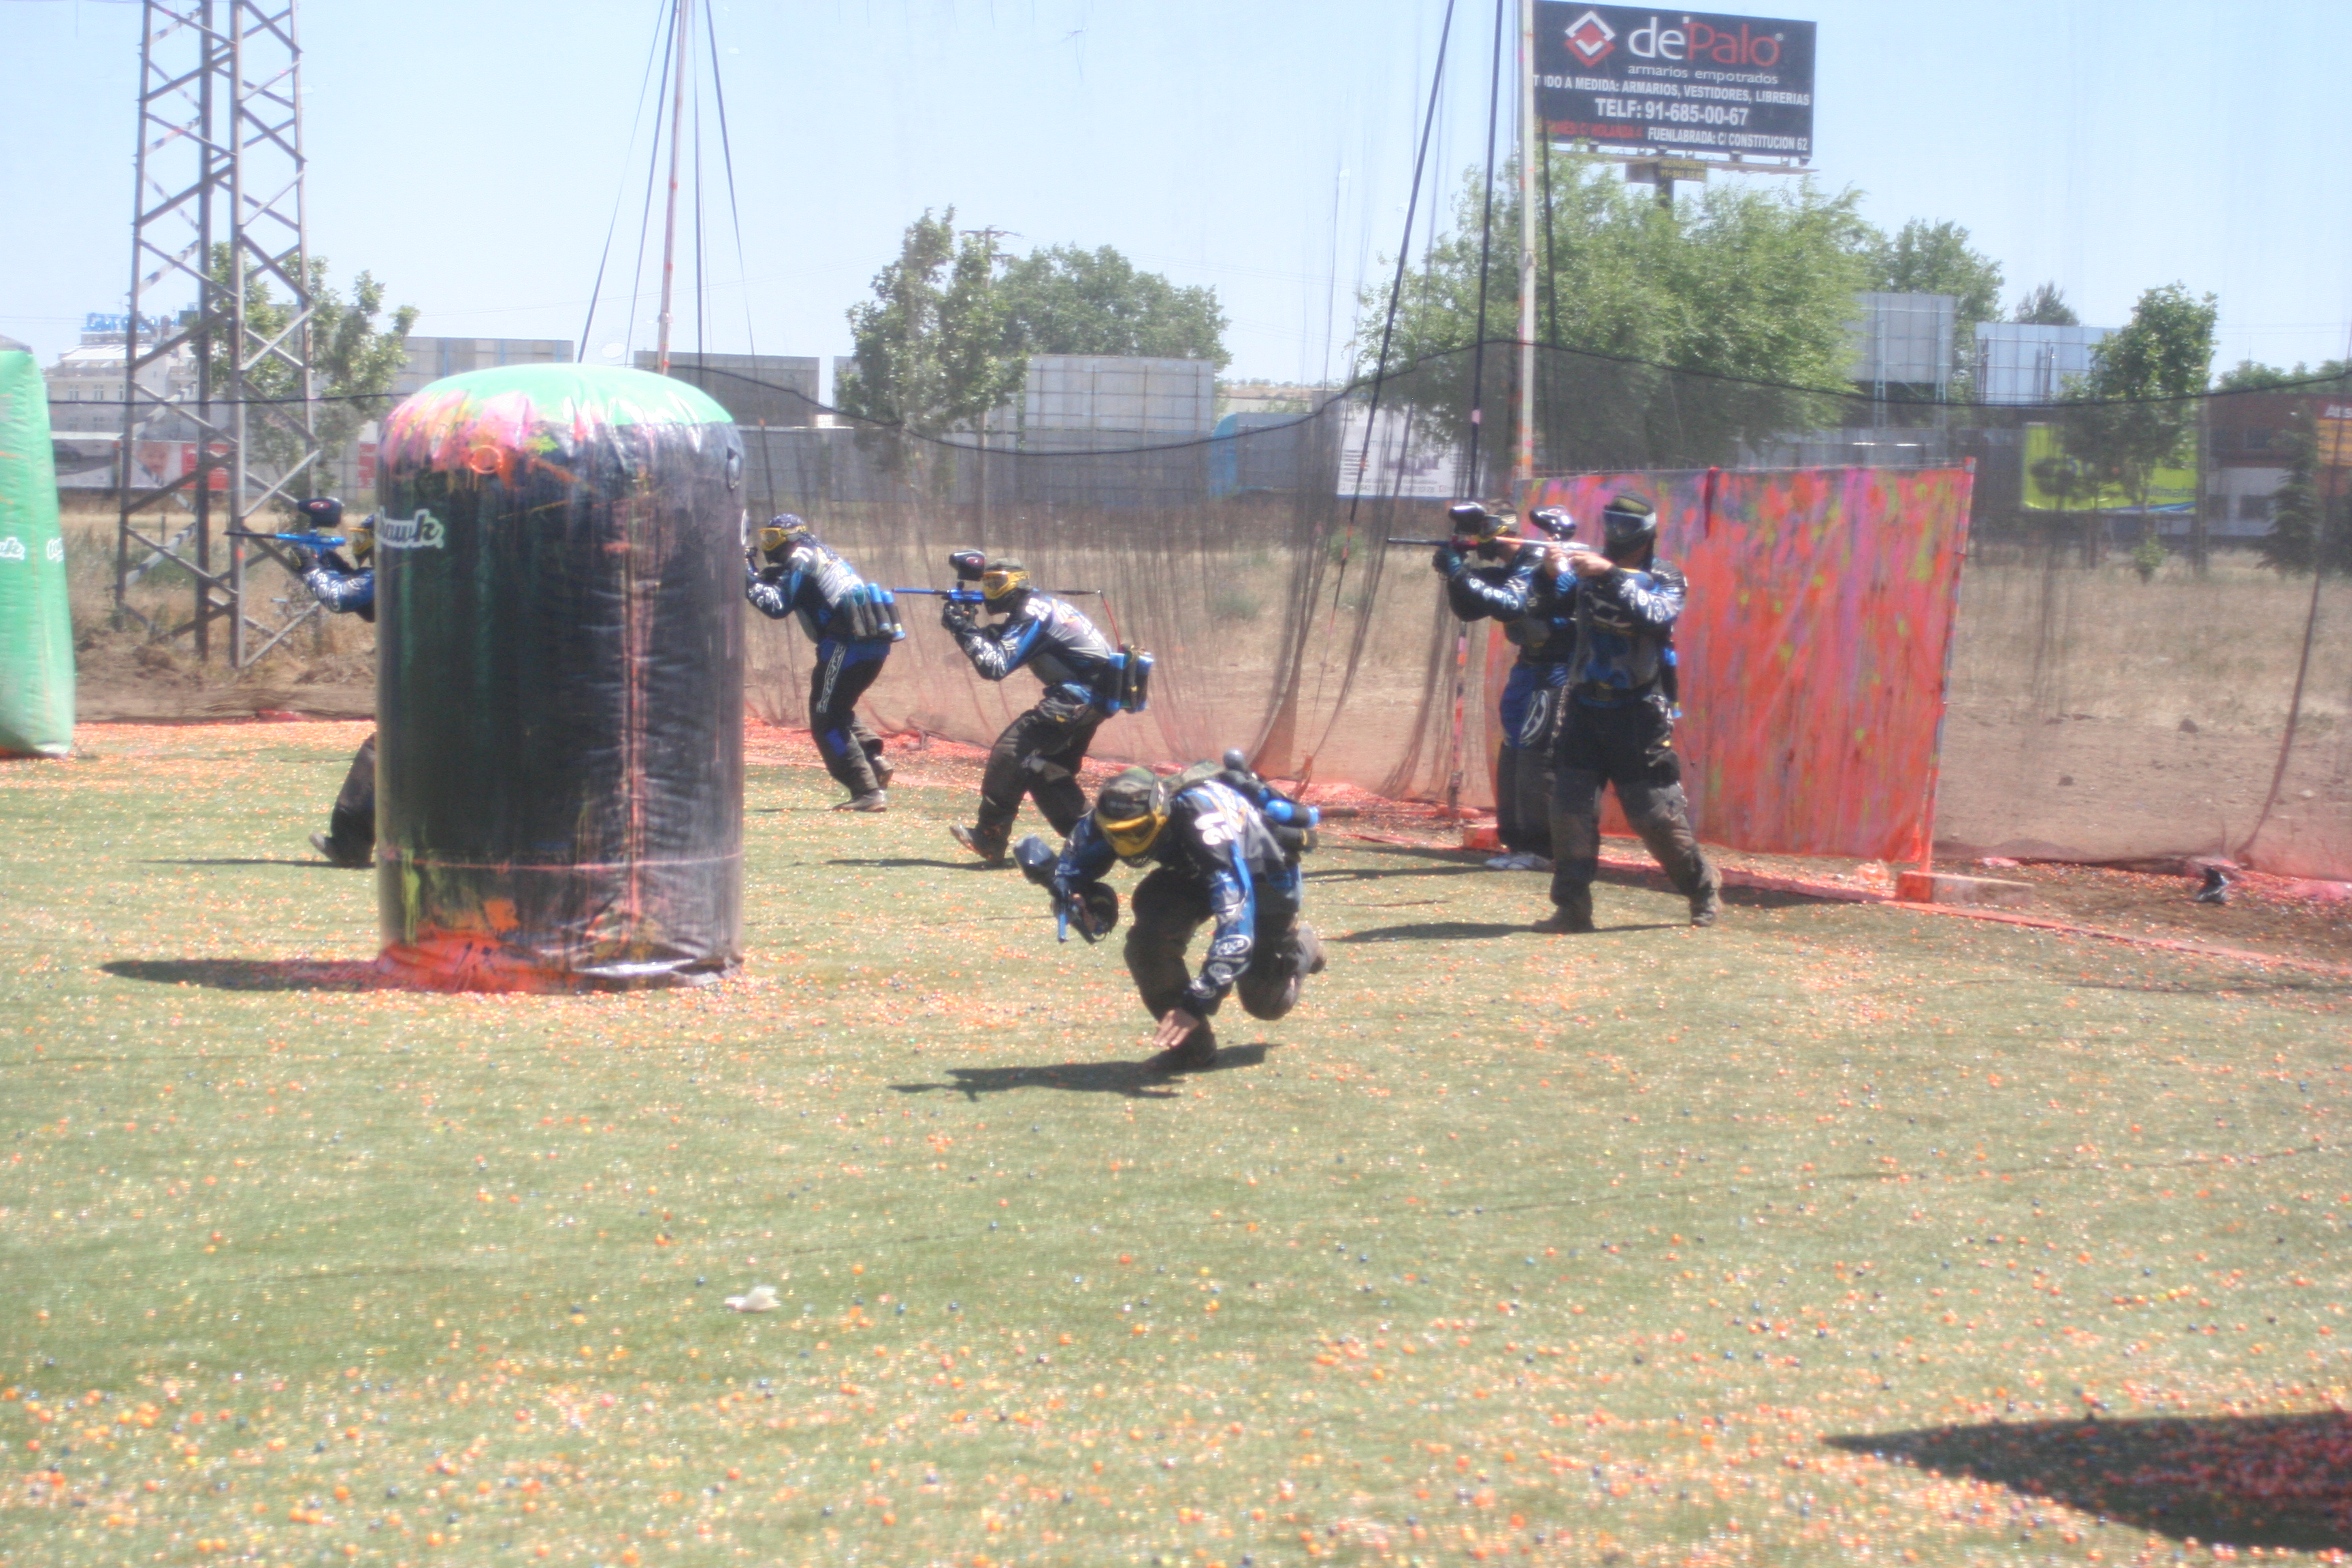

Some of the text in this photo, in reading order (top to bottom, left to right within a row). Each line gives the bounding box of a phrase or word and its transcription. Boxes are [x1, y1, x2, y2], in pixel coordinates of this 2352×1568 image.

[1628, 65, 1778, 84] armarios empotrados
[1531, 74, 1810, 106] TDO A MEDIDA: ARMARIOS, VESTIDORES, LIBRERIAS
[1595, 97, 1749, 127] TELF: 91-685-00-67
[1648, 127, 1716, 143] FUENLABRADA:
[1728, 133, 1795, 150] CONSTITUCION
[1797, 137, 1808, 151] 62
